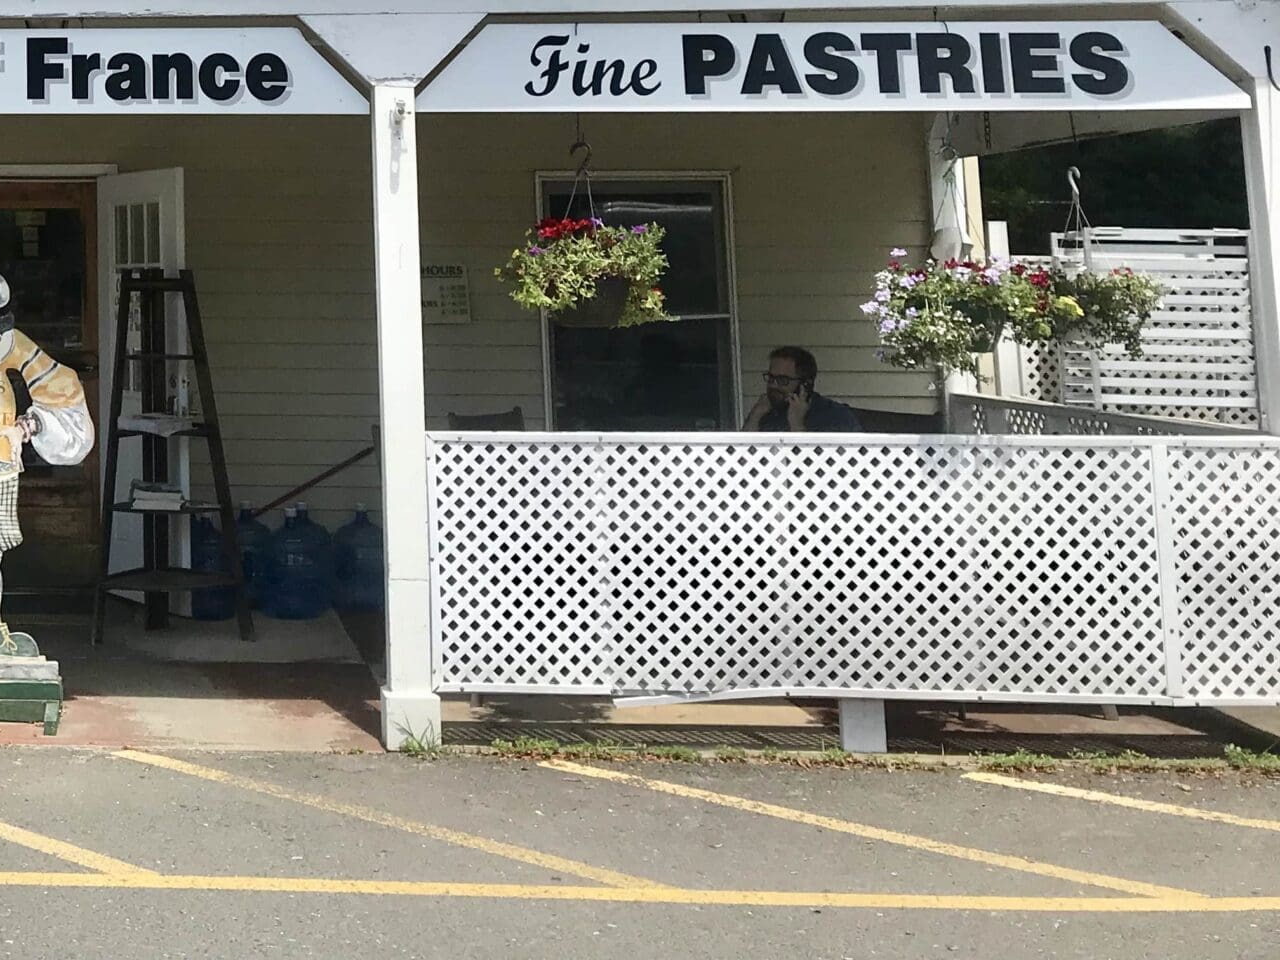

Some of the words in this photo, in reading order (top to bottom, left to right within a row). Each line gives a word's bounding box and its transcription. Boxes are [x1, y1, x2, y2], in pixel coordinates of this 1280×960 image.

[26, 37, 290, 102] France
[524, 34, 662, 97] Fine
[682, 31, 1130, 96] PASTRIES
[422, 265, 464, 276] HOURS
